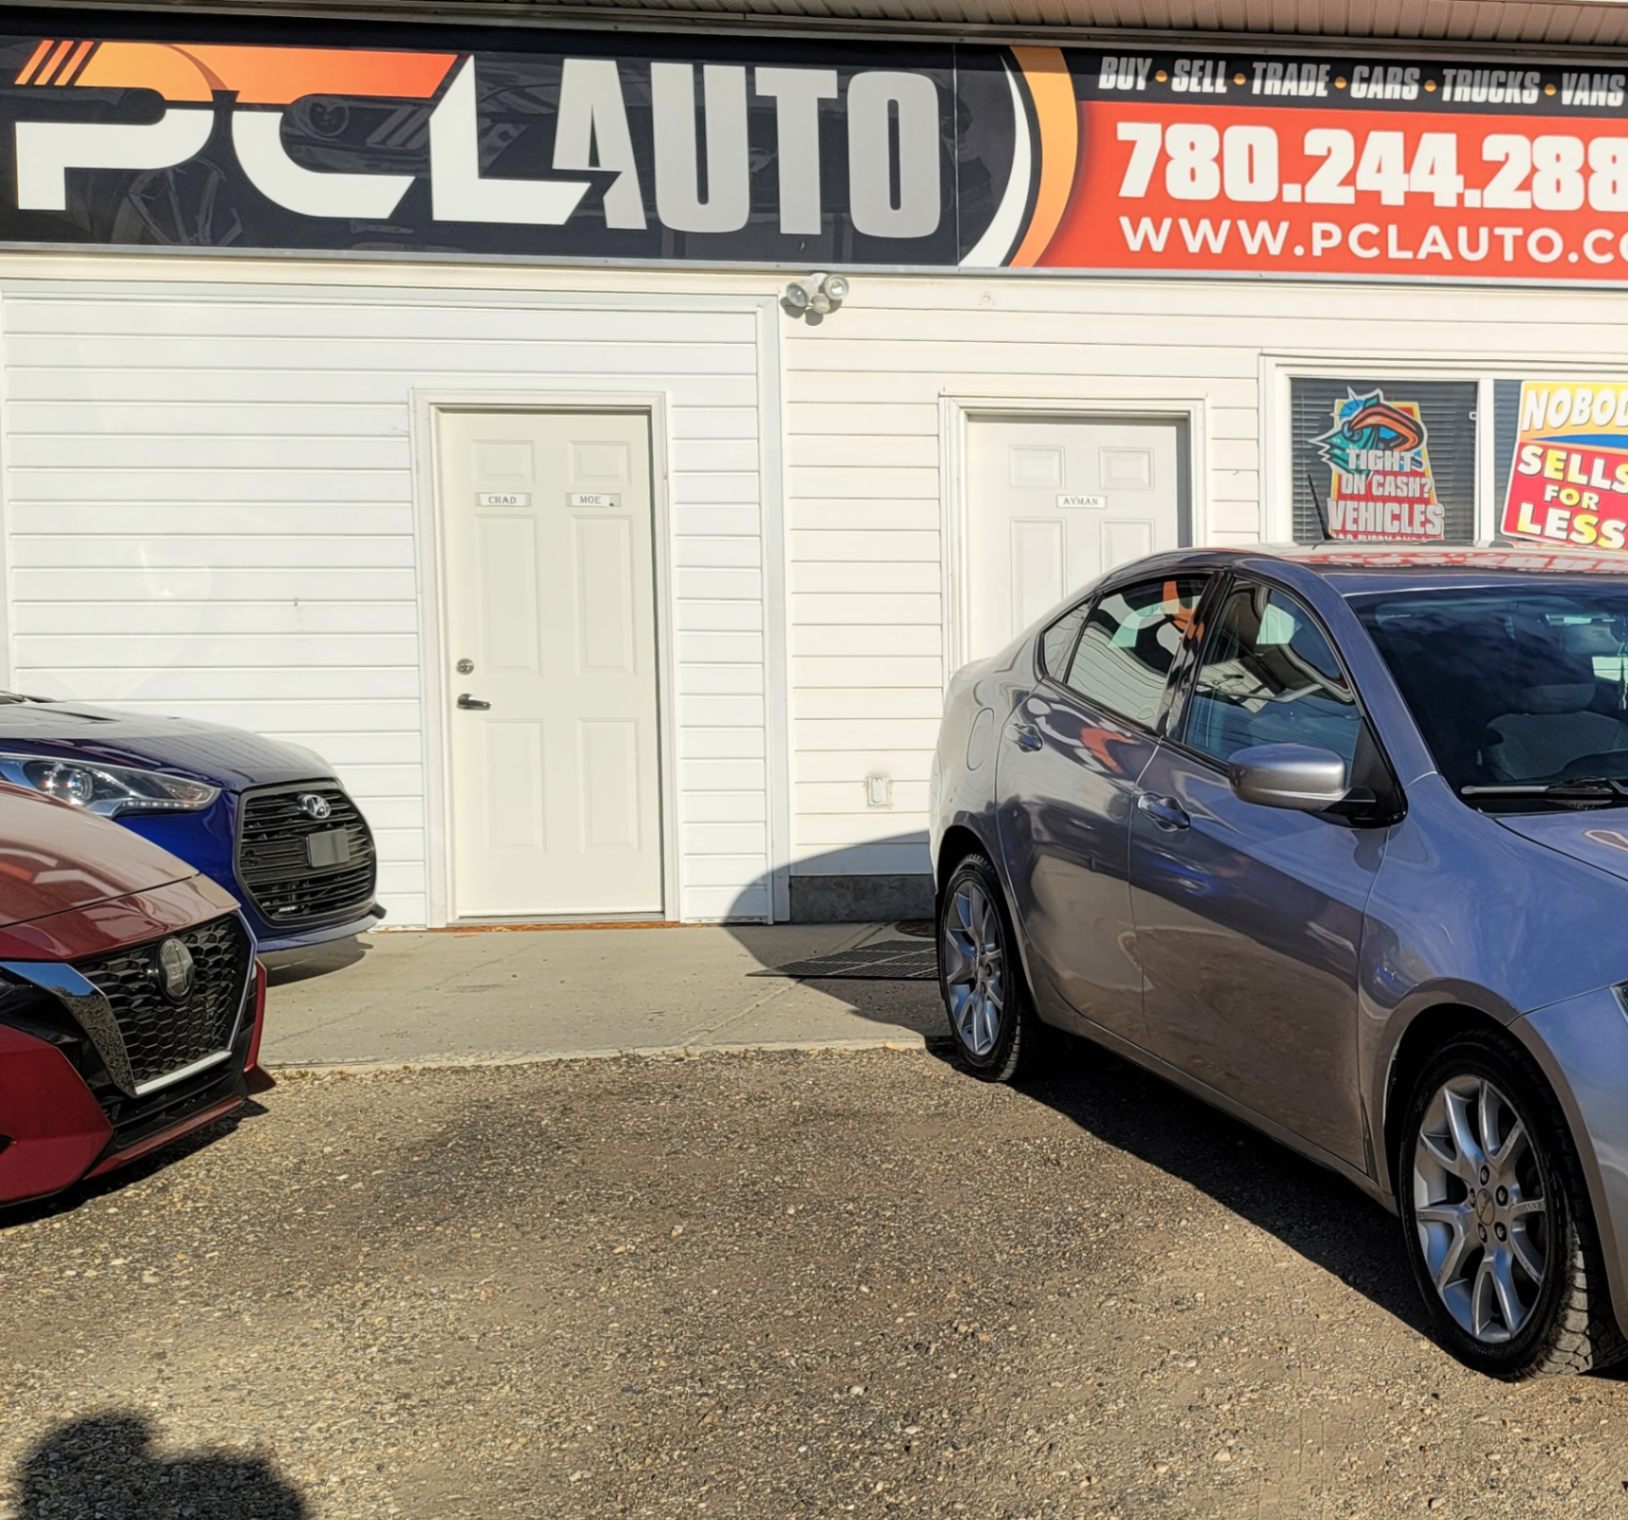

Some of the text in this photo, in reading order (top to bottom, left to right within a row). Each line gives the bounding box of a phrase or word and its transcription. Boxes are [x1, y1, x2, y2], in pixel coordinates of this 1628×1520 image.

[1098, 56, 1152, 91] BUY
[1171, 59, 1227, 93] SELL
[1251, 62, 1331, 97] TRADE
[1350, 65, 1420, 100] CARS
[1441, 69, 1541, 104] TRUCKS
[1561, 73, 1626, 107] VANS
[1346, 448, 1413, 472] TIGHT
[1341, 472, 1434, 499] ON CASH?
[1544, 484, 1600, 511] FOR
[1327, 498, 1445, 535] VEHICLES
[1516, 502, 1628, 550] LESS
